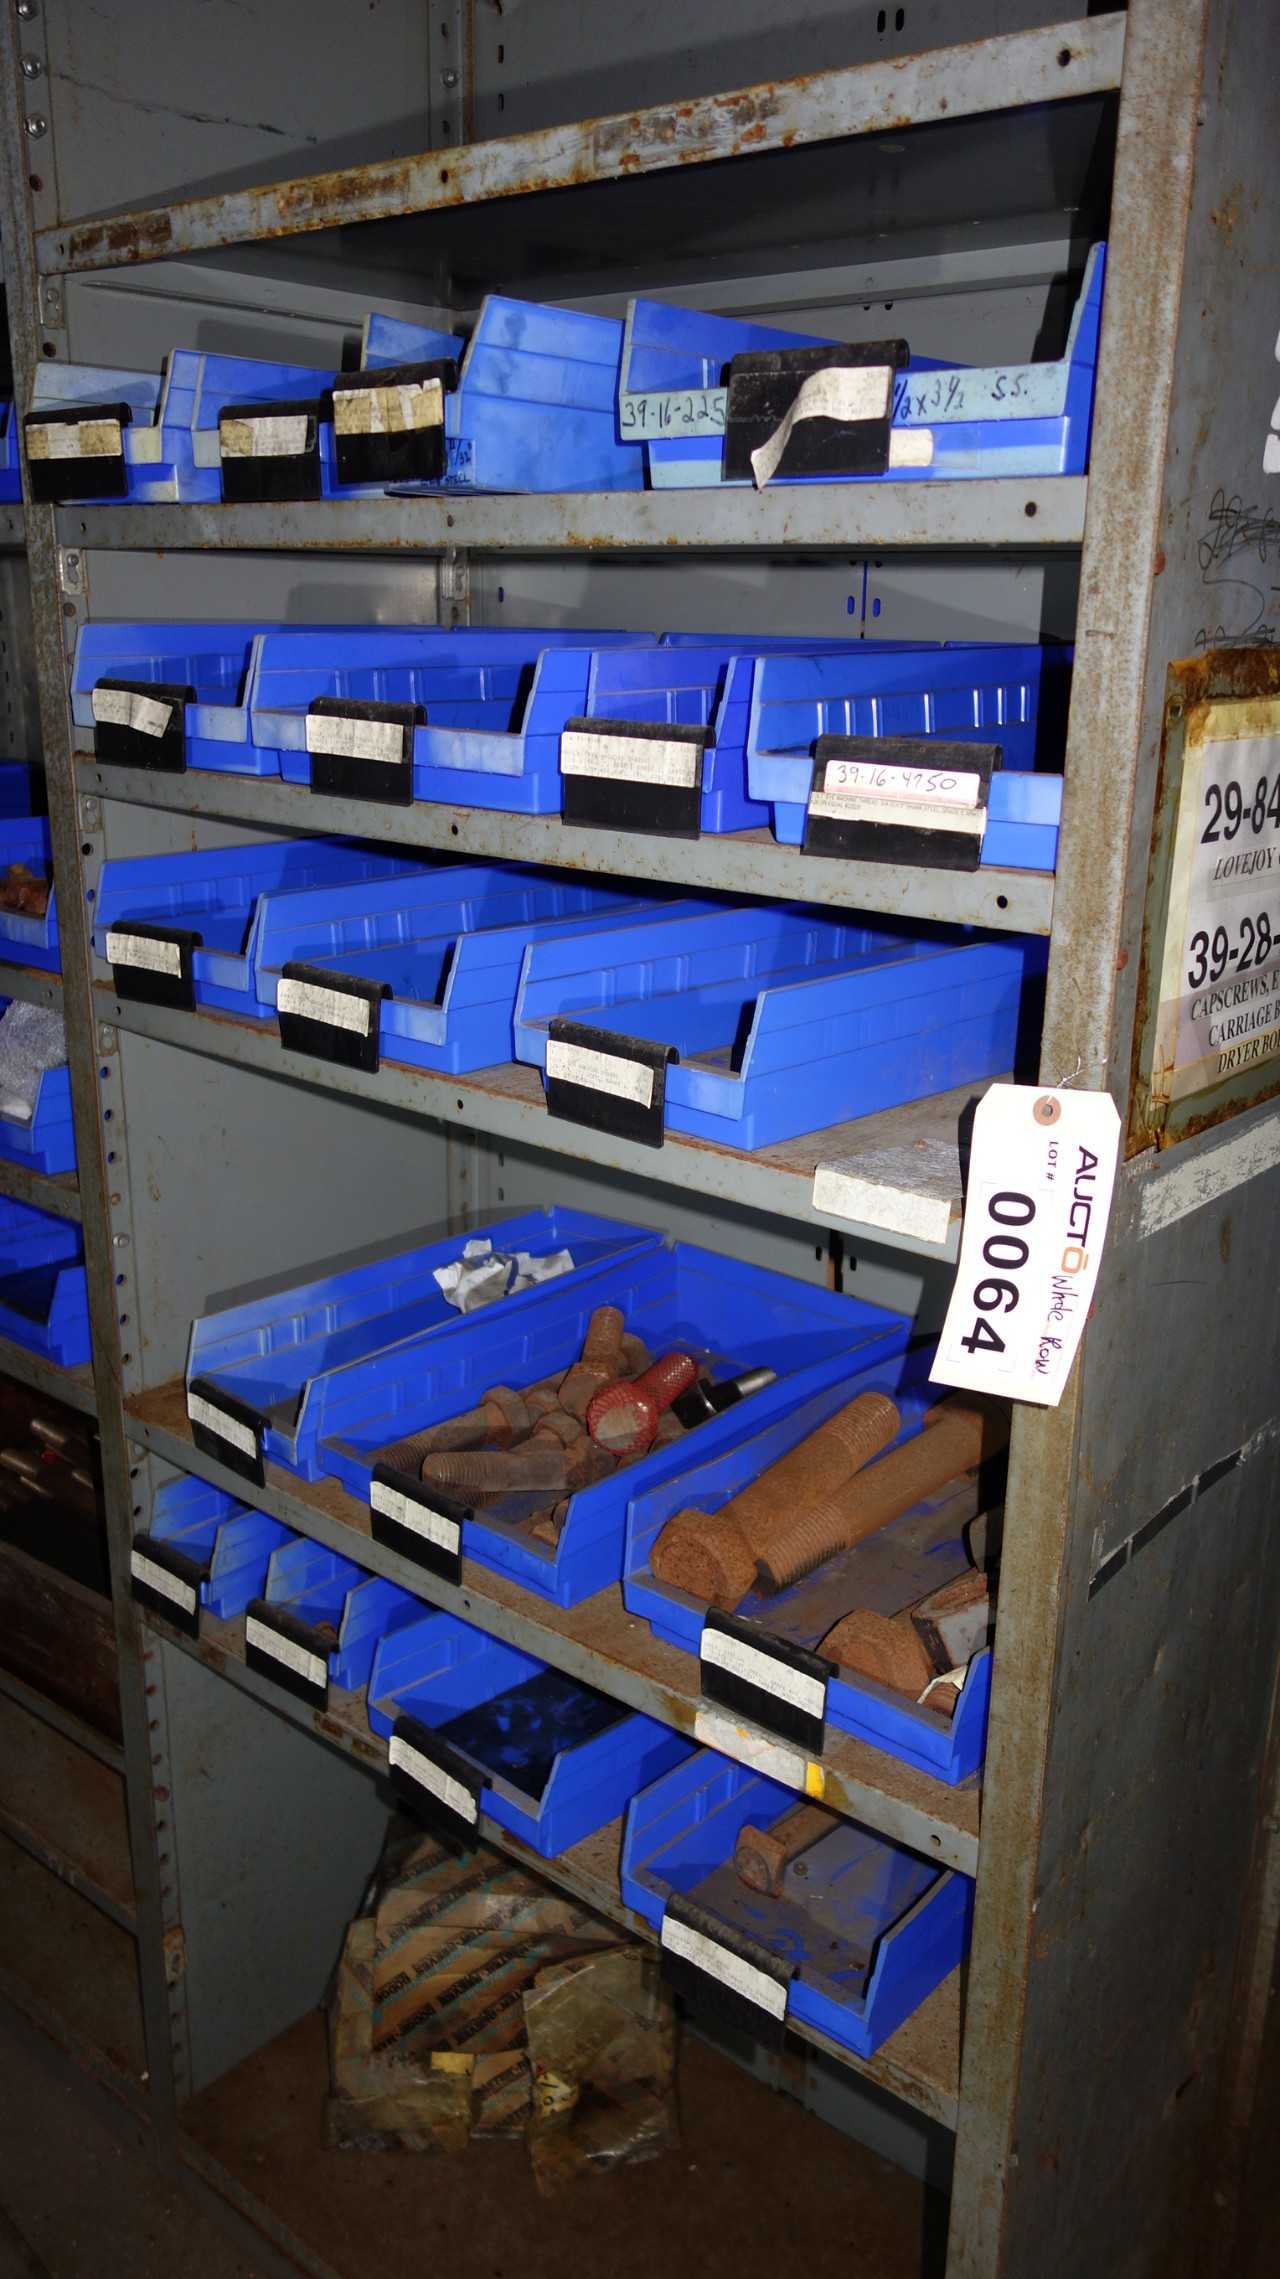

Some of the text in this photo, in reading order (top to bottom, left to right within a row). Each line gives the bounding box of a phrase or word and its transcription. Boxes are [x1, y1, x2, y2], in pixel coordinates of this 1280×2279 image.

[1213, 848, 1277, 880] LOVEJOY
[1208, 1003, 1272, 1047] CARRIAGE
[1218, 1038, 1261, 1074] DRYER
[1047, 1142, 1059, 1169] LOT
[961, 1192, 1037, 1354] 0064
[1035, 1336, 1063, 1375] Row
